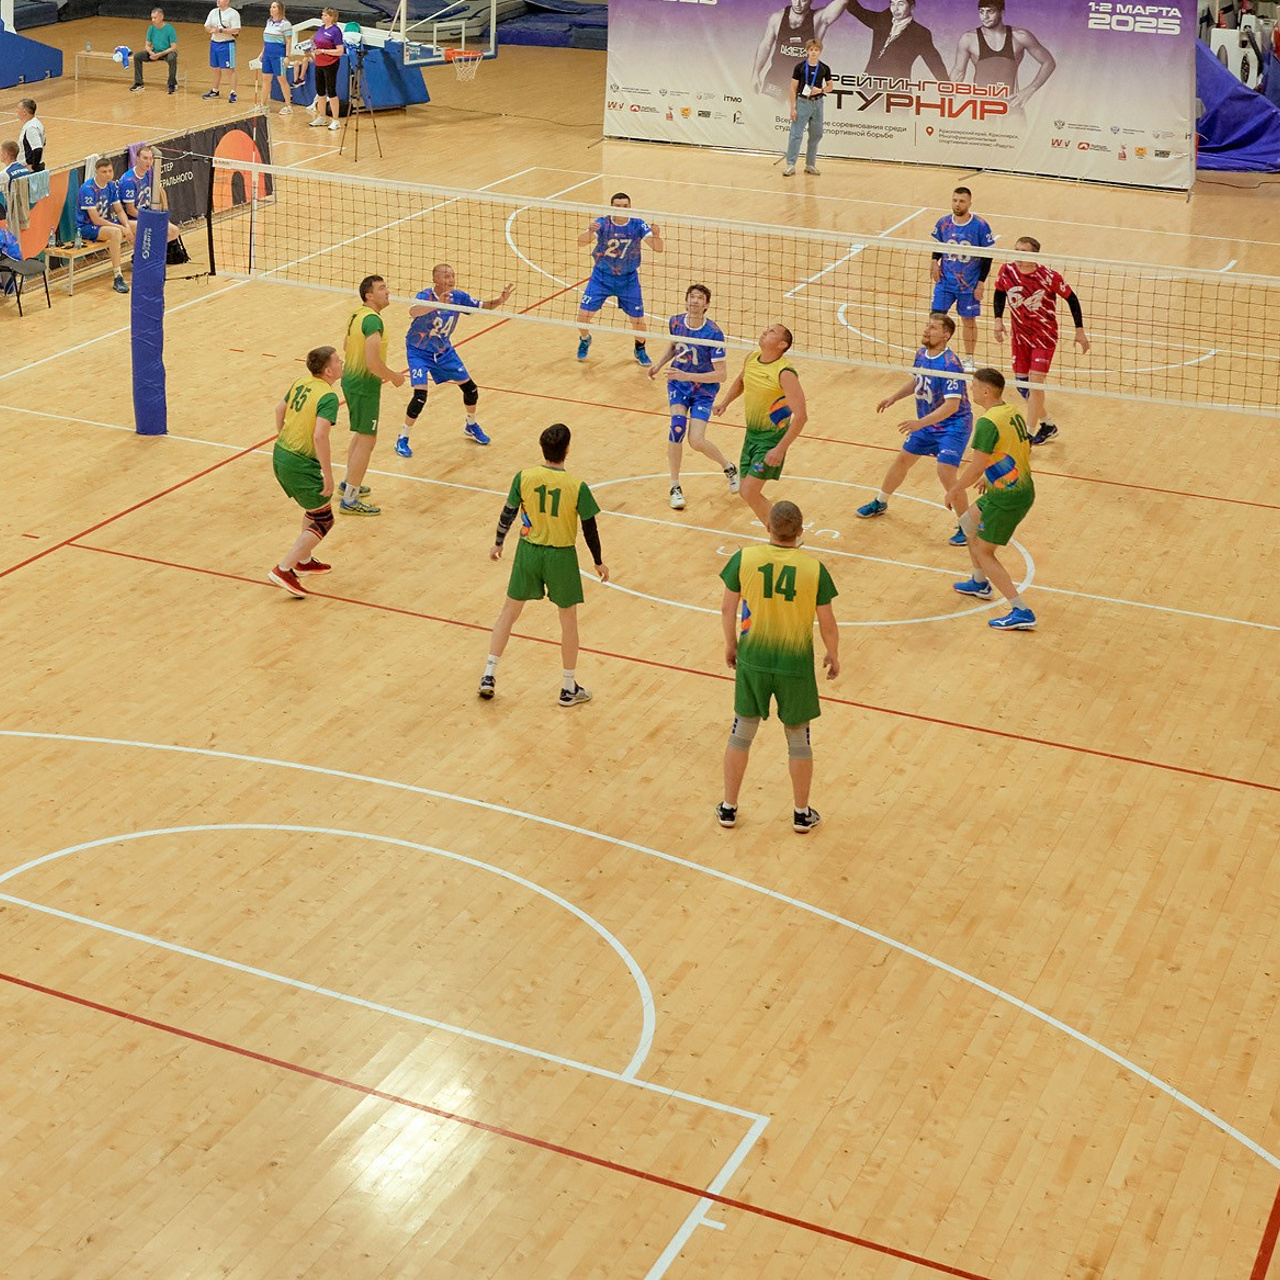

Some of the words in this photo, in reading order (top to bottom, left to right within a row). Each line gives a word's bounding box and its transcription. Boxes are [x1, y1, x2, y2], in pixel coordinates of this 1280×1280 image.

[1088, 2, 1112, 12] 1-2
[1116, 3, 1182, 18] МАРТА
[1087, 13, 1181, 35] 2025
[831, 73, 1009, 98] РЕЙТИНГОВЫЙ
[830, 89, 1008, 121] ТУРНИР
[823, 128, 865, 137] спортивной
[866, 130, 893, 139] борьбе
[832, 121, 883, 131] соревнования
[885, 124, 907, 133] среди
[85, 196, 93, 204] 22
[126, 189, 135, 198] 23
[604, 238, 632, 260] 27
[430, 316, 455, 338] 24
[675, 343, 699, 365] 21
[411, 369, 423, 379] 24
[946, 380, 958, 390] 25
[290, 384, 312, 413] 15
[914, 374, 933, 404] 25
[371, 420, 378, 431] 7
[534, 484, 561, 518] 11
[757, 562, 797, 602] 14
